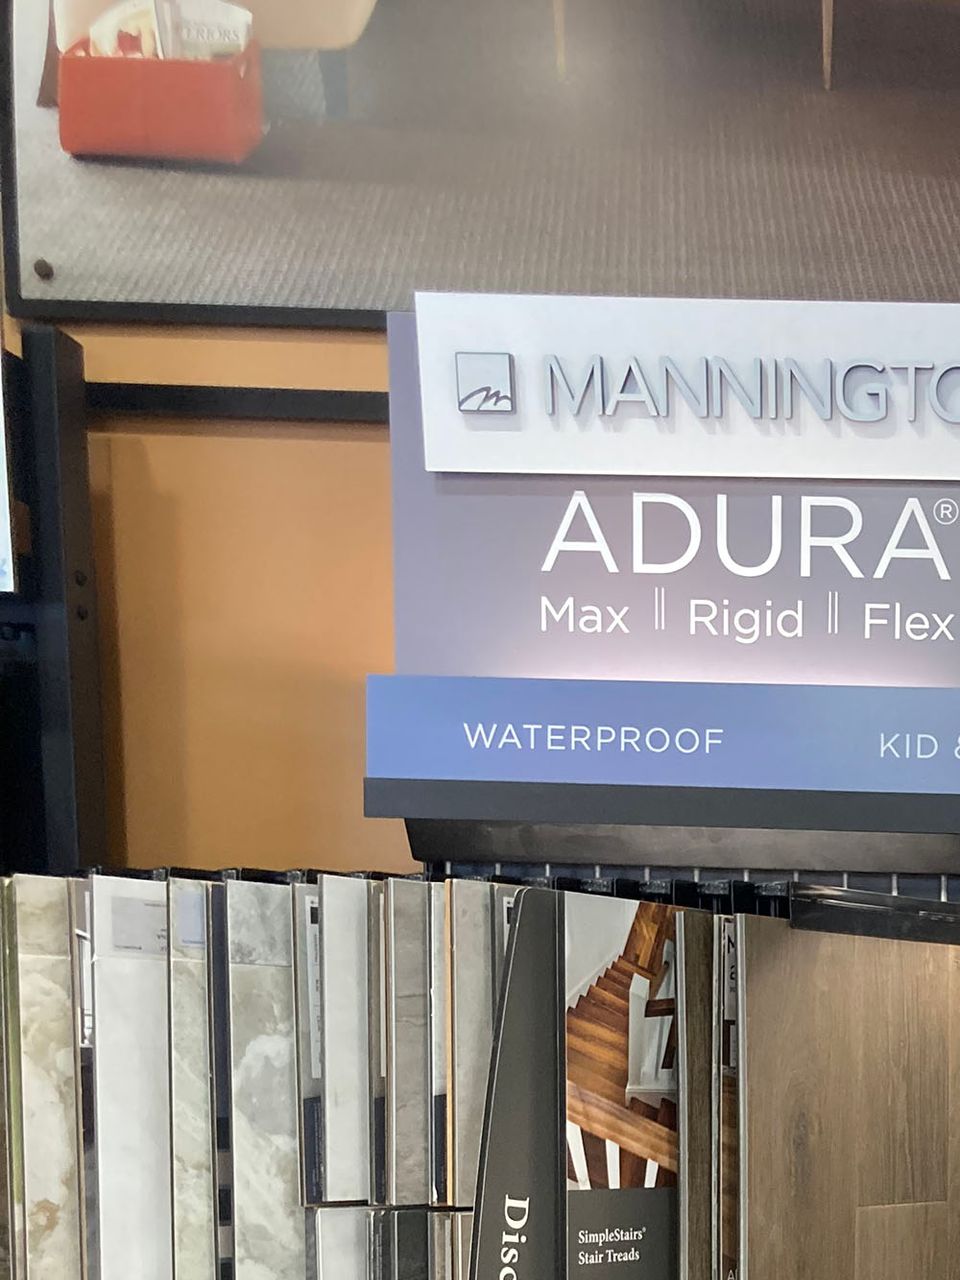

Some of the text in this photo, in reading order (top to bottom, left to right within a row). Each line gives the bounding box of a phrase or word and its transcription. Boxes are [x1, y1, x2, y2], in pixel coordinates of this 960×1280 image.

[541, 596, 955, 645] Max Rigid Flex
[464, 723, 724, 754] WATERPROOF
[880, 733, 939, 759] KID
[578, 1247, 640, 1265] Stair Treads
